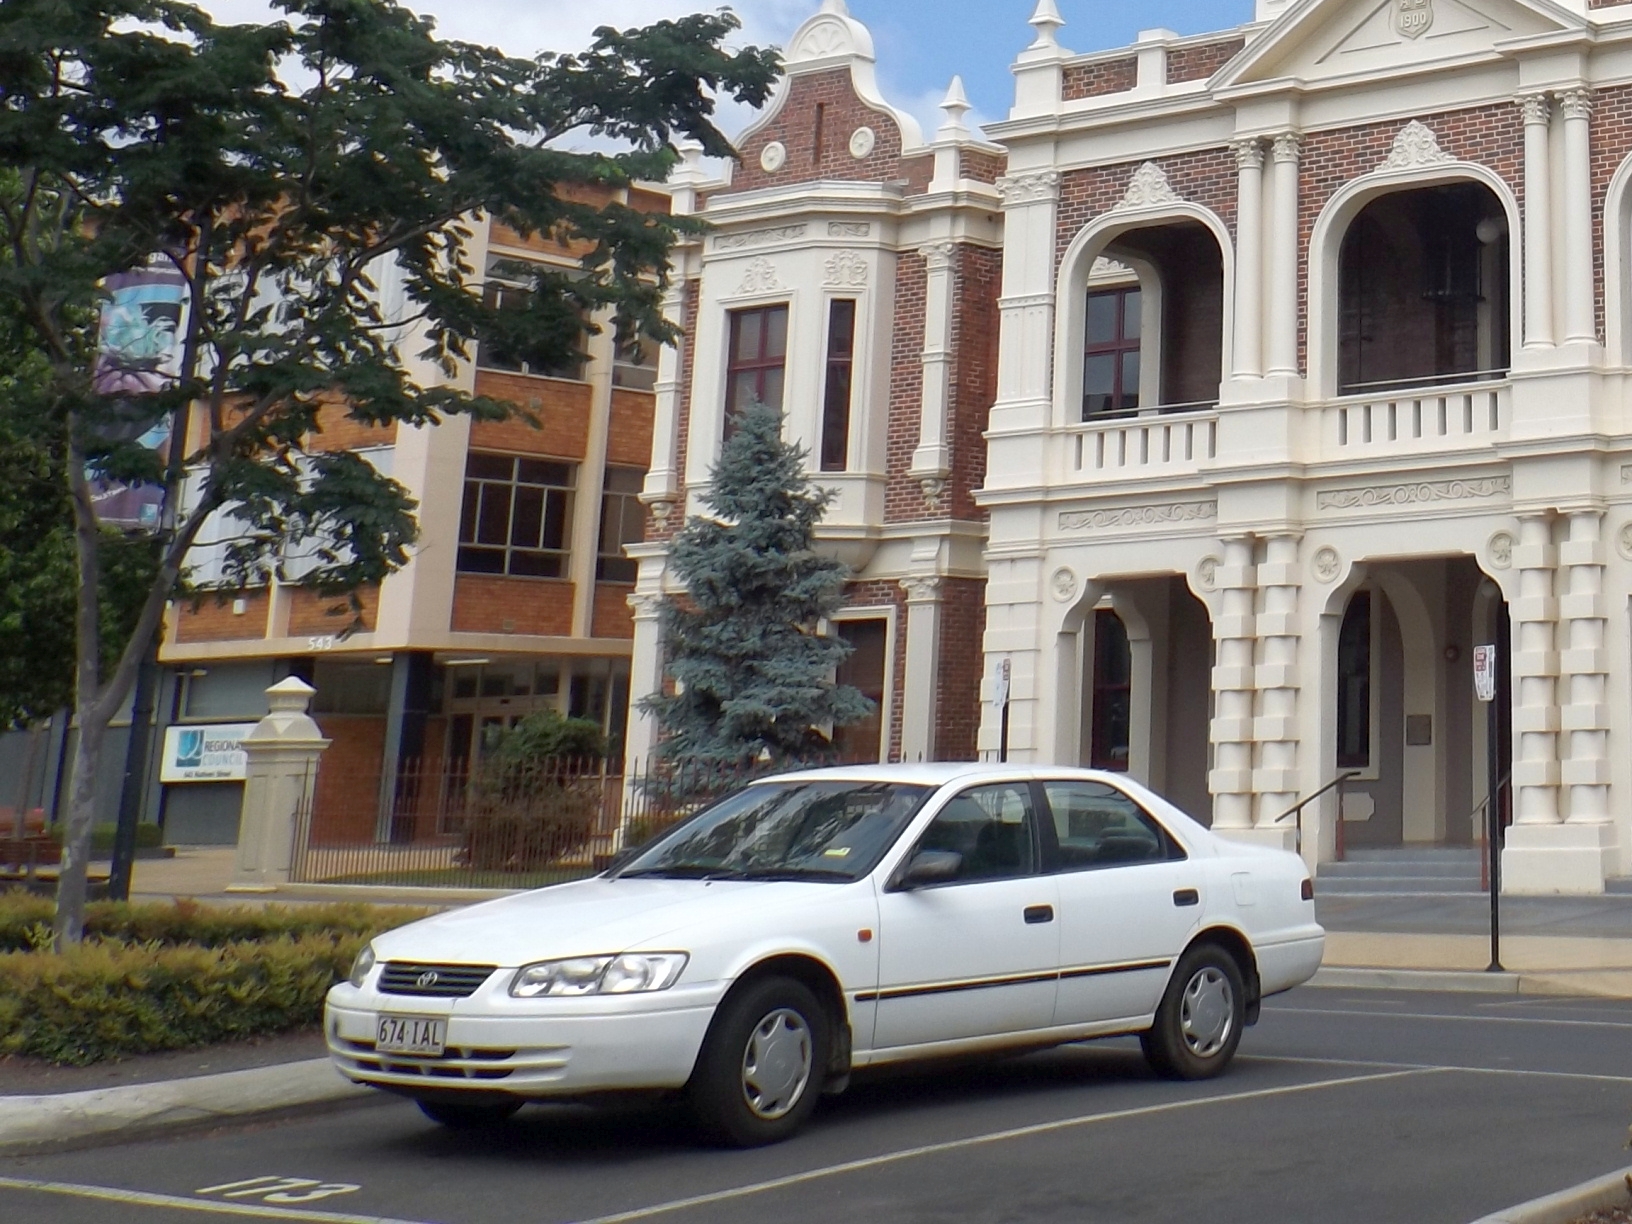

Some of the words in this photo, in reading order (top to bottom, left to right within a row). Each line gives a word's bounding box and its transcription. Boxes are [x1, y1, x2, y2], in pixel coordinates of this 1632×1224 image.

[1400, 12, 1426, 27] 1900
[308, 636, 332, 651] 543
[204, 739, 242, 753] REGIONA
[194, 1175, 363, 1205] 173
